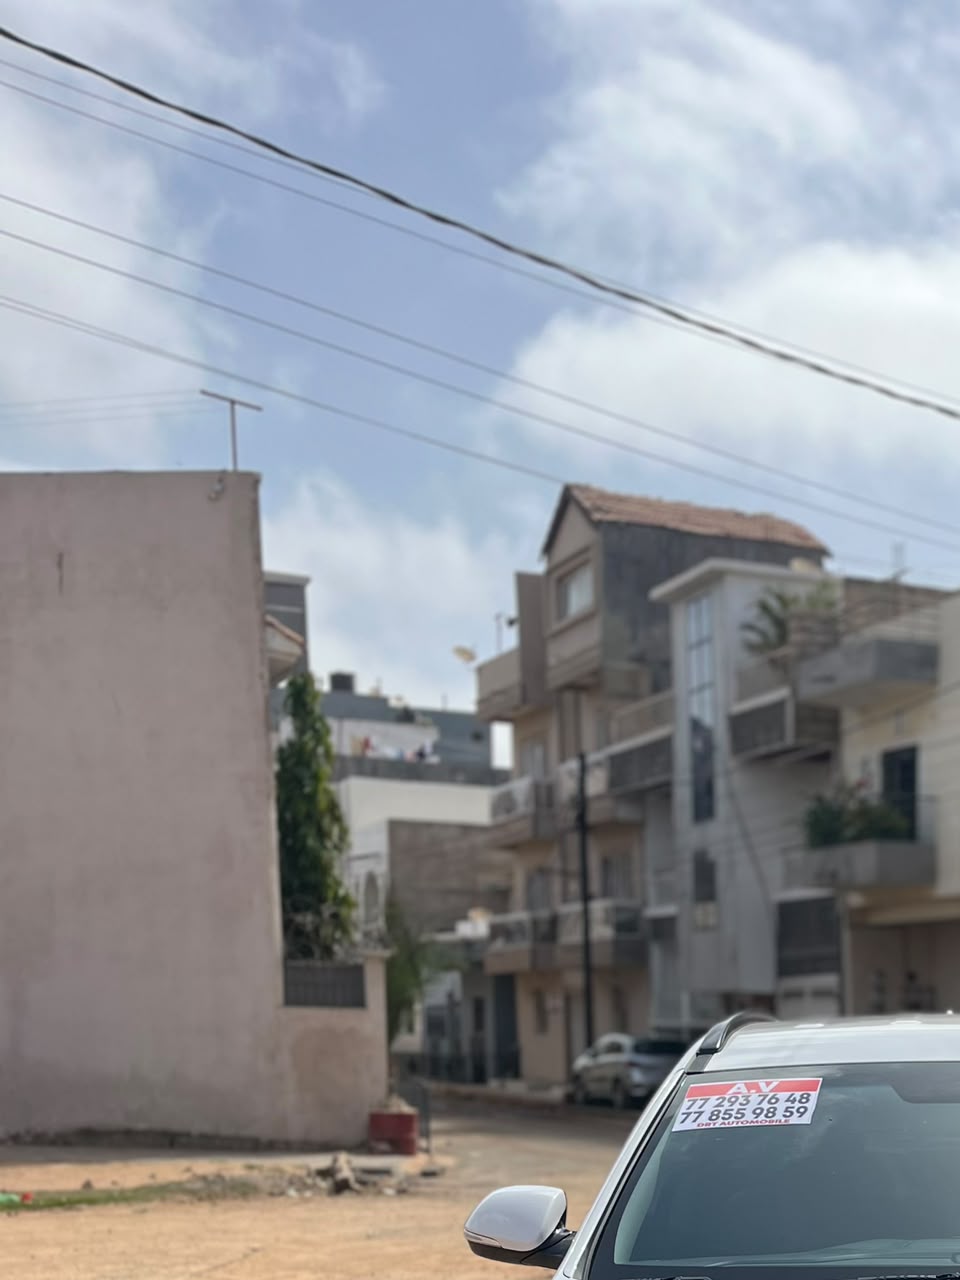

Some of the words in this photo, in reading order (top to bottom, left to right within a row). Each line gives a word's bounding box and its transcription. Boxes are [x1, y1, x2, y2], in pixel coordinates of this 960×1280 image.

[725, 1081, 781, 1095] A.V
[685, 1098, 711, 1111] 77
[712, 1095, 754, 1109] 293
[756, 1093, 782, 1106] 76
[785, 1092, 812, 1105] 48
[680, 1111, 704, 1124] 77
[708, 1107, 747, 1122] 855
[752, 1106, 778, 1119] 98
[782, 1105, 809, 1118] 59
[719, 1119, 791, 1127] AUTOMOBILE
